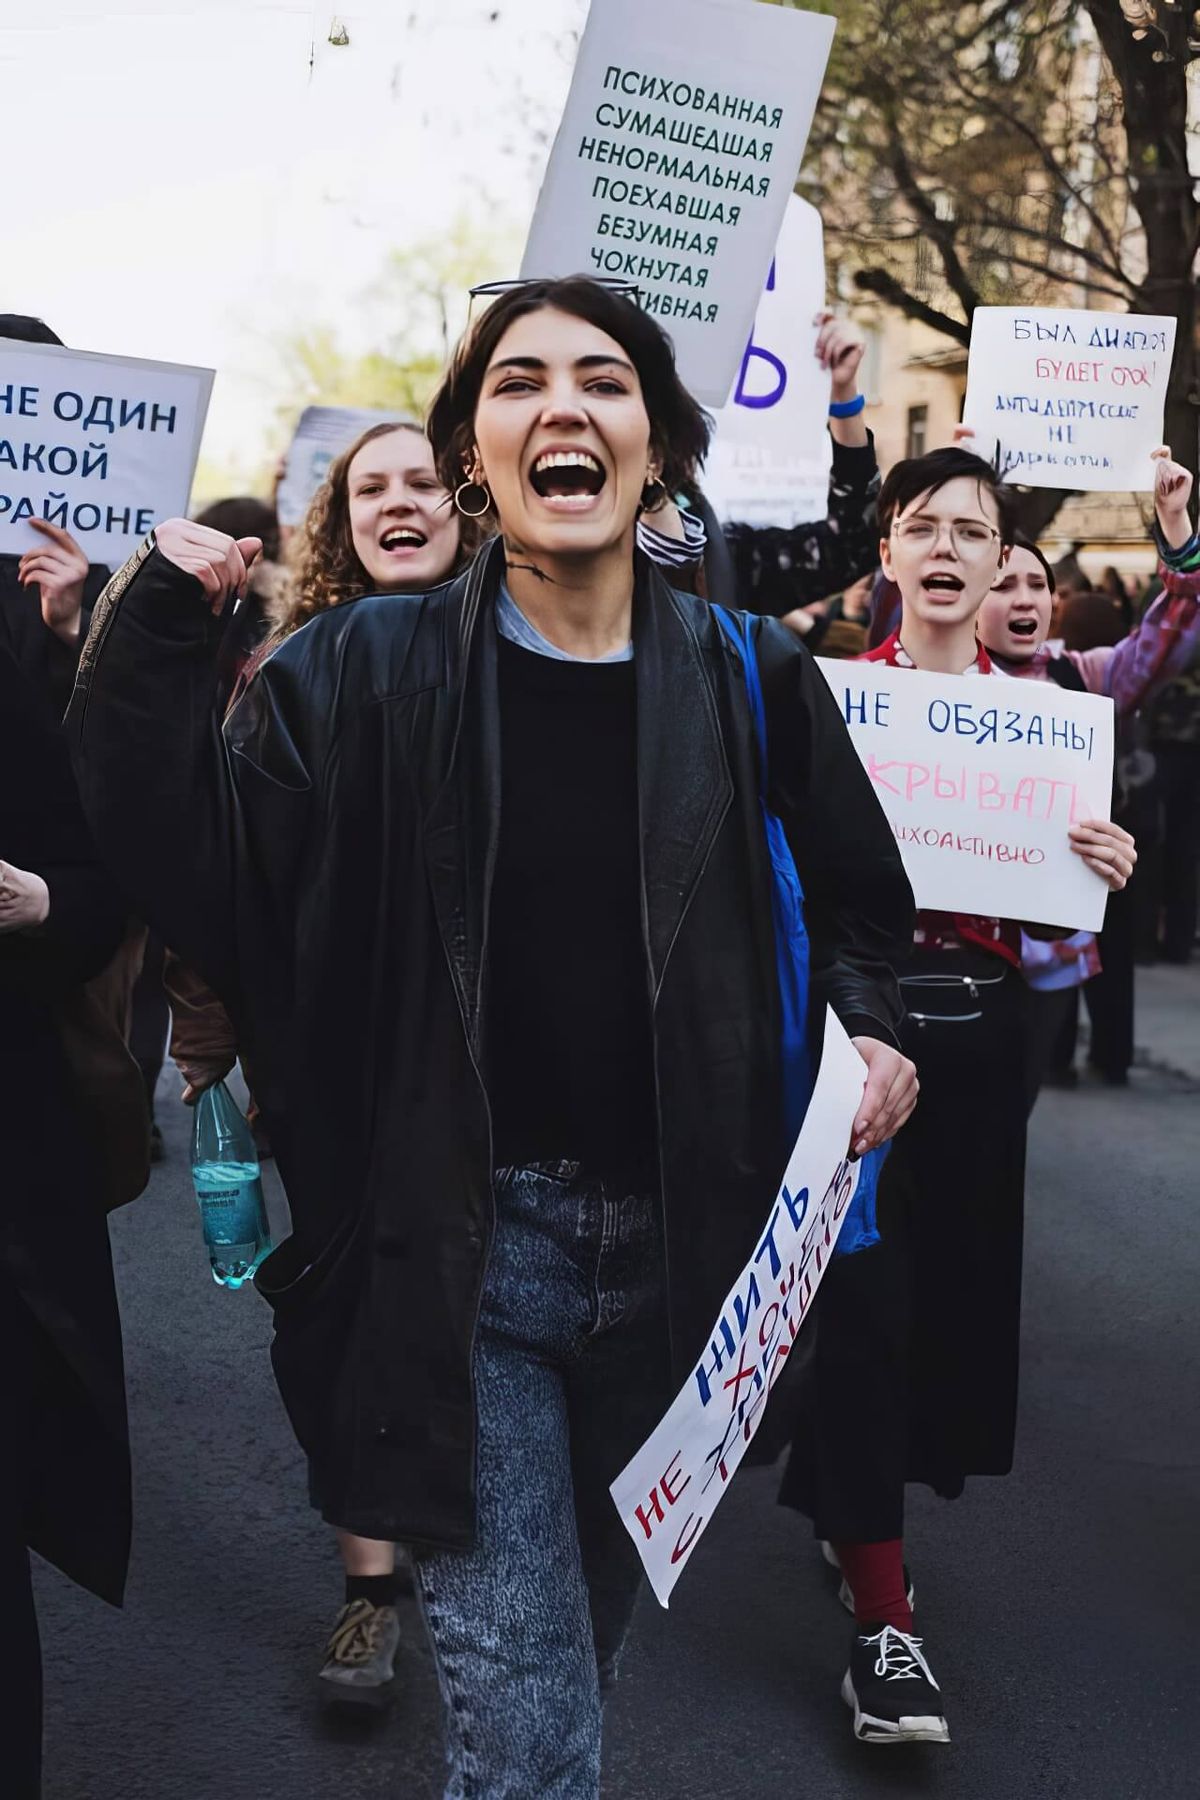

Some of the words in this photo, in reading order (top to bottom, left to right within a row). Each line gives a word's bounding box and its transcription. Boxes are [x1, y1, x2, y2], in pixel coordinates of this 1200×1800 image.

[603, 66, 783, 129] ПСИХОВАННАЯ
[596, 103, 773, 162] СУМАШЕДШАЯ
[578, 136, 770, 198] НЕНОРМАЛЬНАЯ
[592, 176, 741, 226] ПОЕХАВШАЯ
[597, 214, 718, 256] БЕЗУМНАЯ
[591, 248, 708, 288] ЧОКНУТАЯ
[1014, 319, 1076, 344] БЫЛ
[54, 392, 176, 433] ОДИН
[845, 688, 890, 727] НЕ
[928, 700, 1094, 760] ОБЯЗАНЫ
[695, 1185, 809, 1407] ЖИТЬ
[635, 1450, 691, 1539] НЕ
